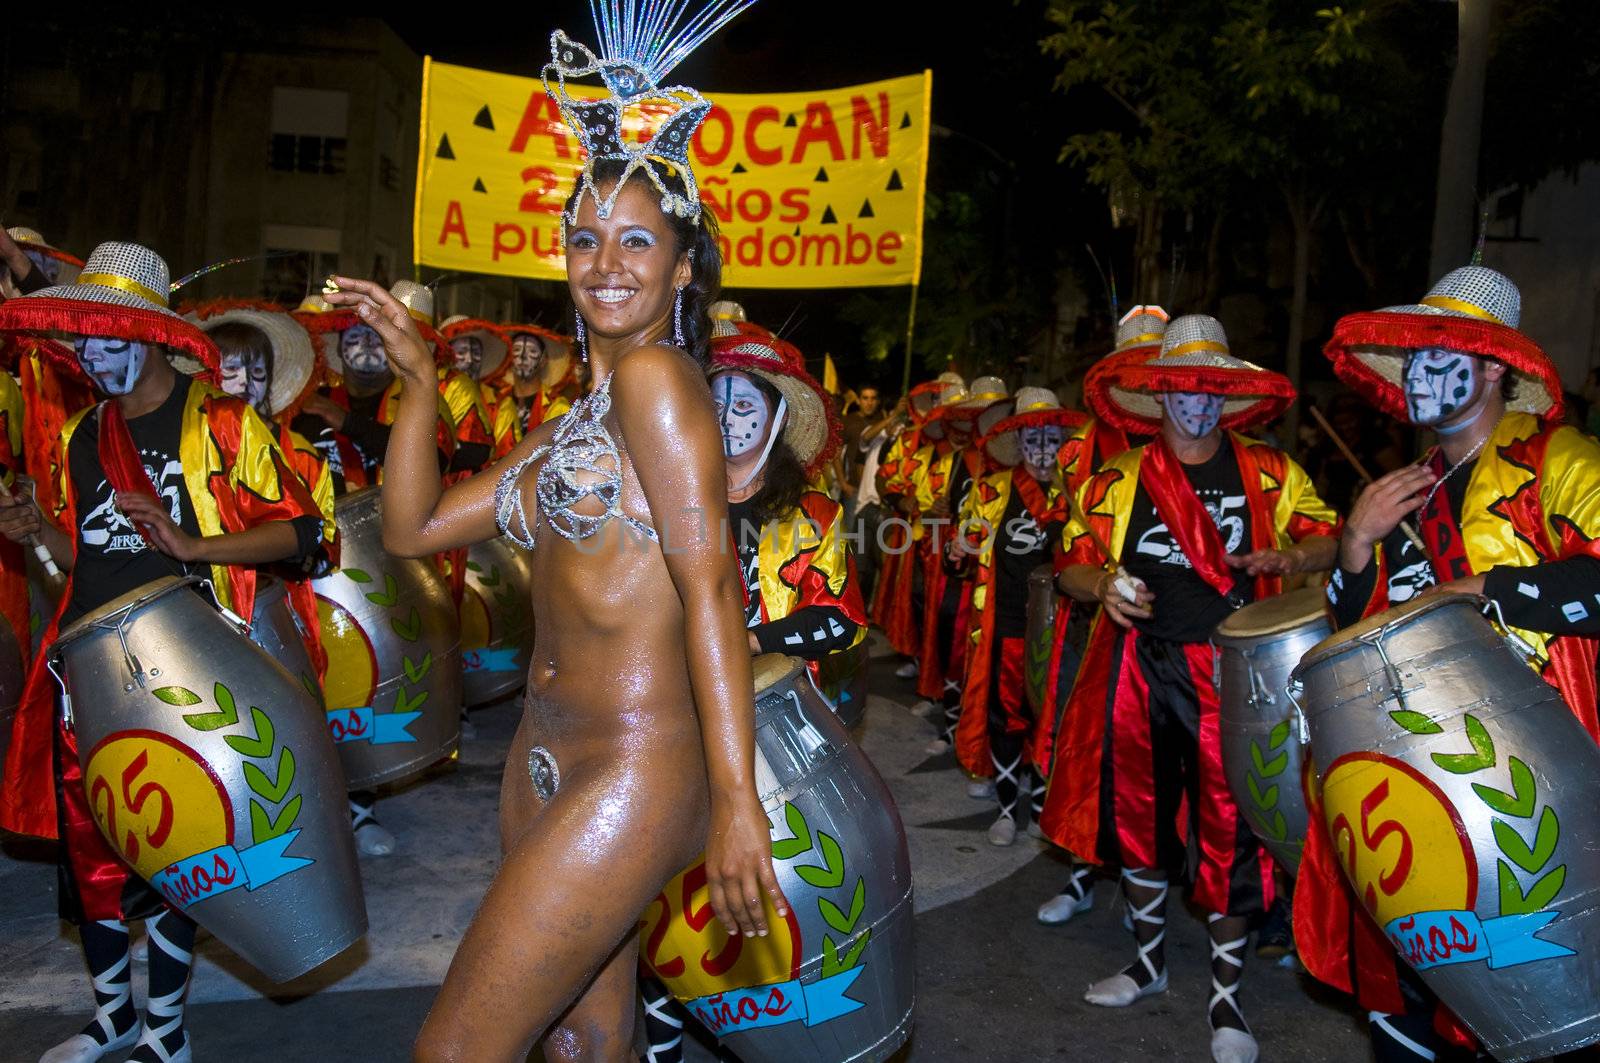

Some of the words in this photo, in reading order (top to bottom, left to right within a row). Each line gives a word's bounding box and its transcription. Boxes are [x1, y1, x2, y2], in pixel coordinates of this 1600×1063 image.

[509, 91, 890, 166] AOCAN
[438, 200, 469, 248] A
[90, 748, 174, 866] 25
[1332, 777, 1414, 919] 25
